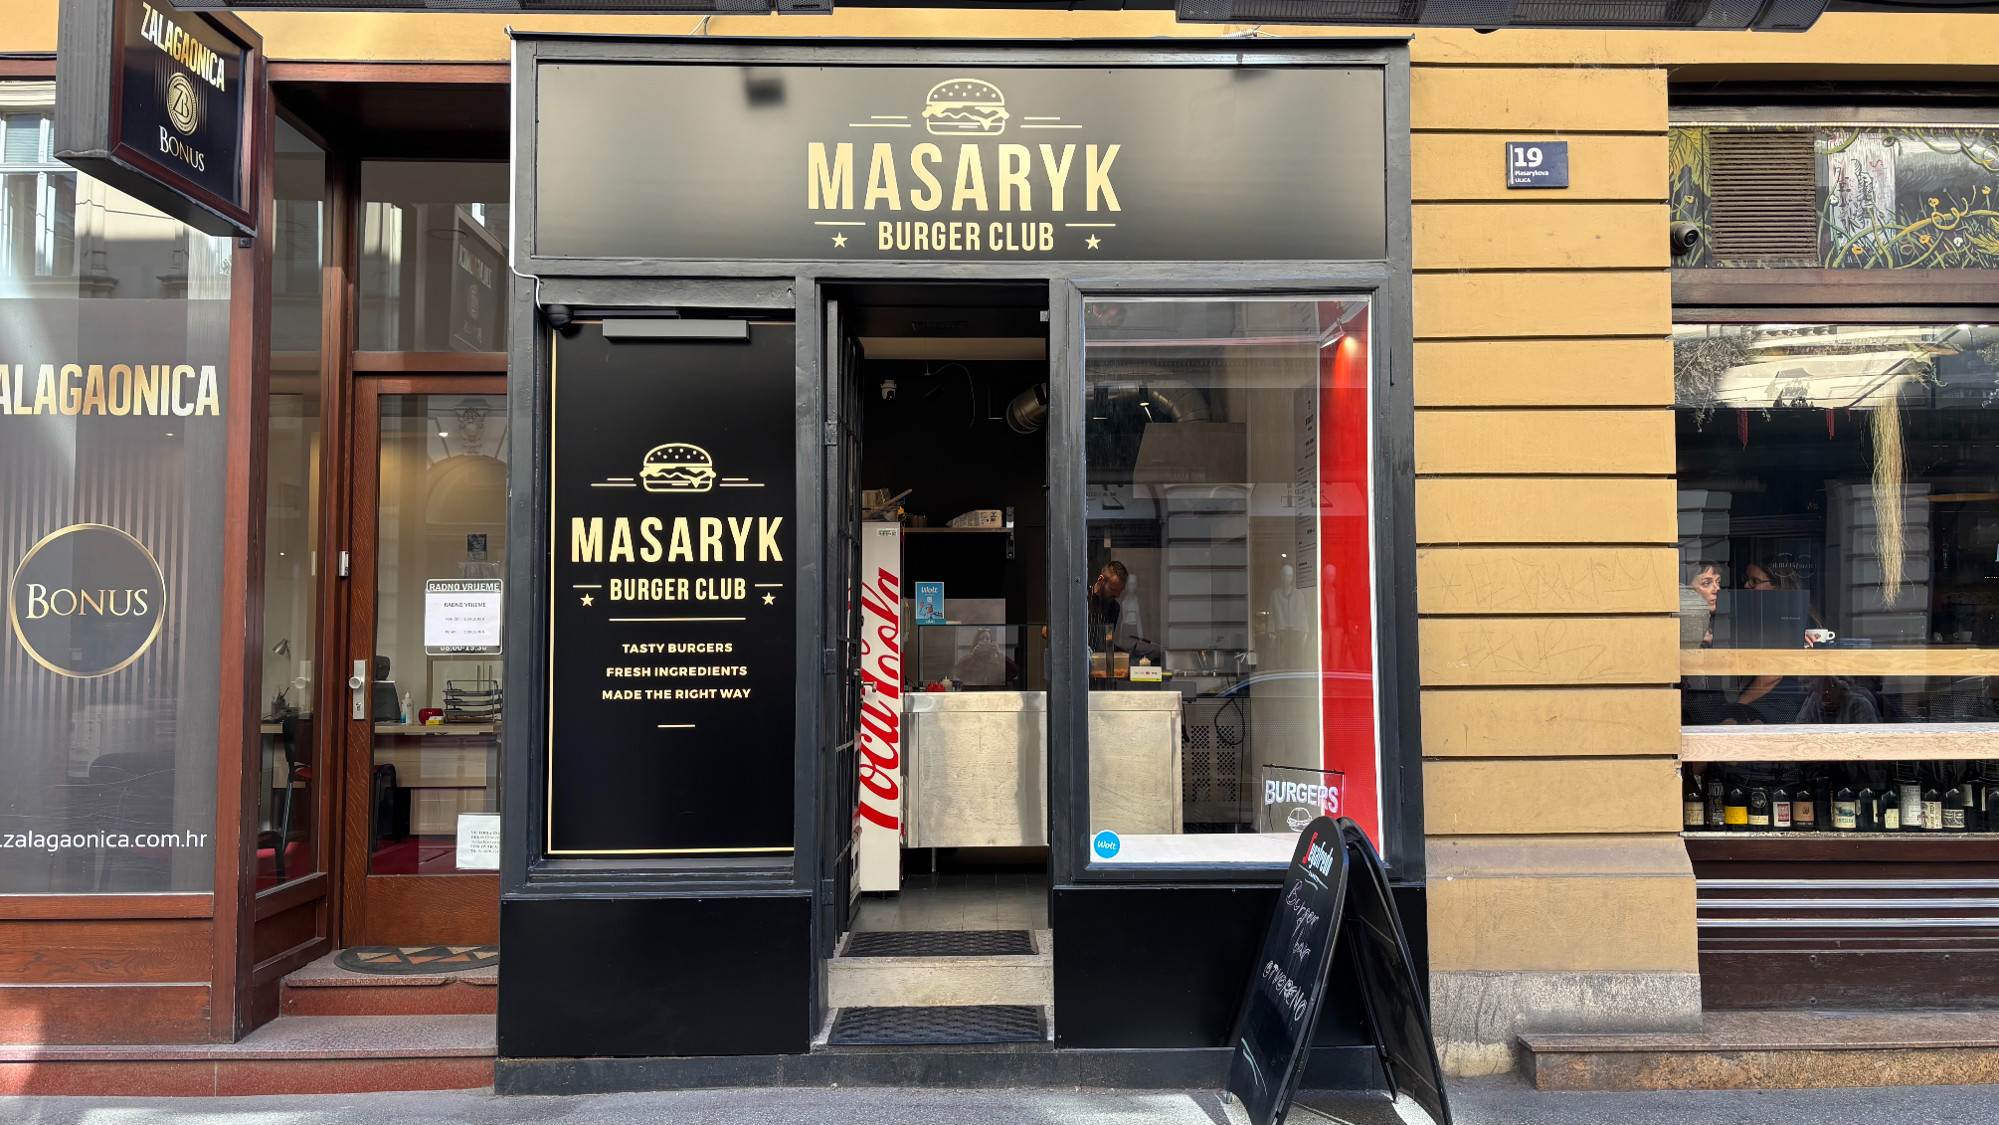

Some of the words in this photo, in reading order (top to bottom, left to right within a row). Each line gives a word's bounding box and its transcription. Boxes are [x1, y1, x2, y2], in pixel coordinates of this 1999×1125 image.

[141, 1, 225, 92] ZALAGAONICA
[159, 125, 205, 172] BONUS
[1514, 147, 1543, 167] 19
[808, 142, 1122, 212] MASARYK
[878, 221, 981, 251] BURGER
[989, 222, 1054, 251] CLUB
[571, 517, 784, 562] MASARYK
[25, 583, 149, 619] BONUS
[429, 583, 461, 591] RADNO
[462, 583, 500, 591] VRIJEME
[610, 578, 689, 601] BURGER
[695, 577, 746, 600] CLUB
[622, 643, 665, 654] TASTY
[667, 643, 733, 653] BURGERS
[606, 667, 651, 677] FRESH
[654, 666, 748, 677] INGREDIENTS
[602, 690, 642, 700] MADE
[645, 689, 672, 699] THE
[675, 689, 717, 699] RIGHT
[720, 688, 751, 699] WAY
[1265, 780, 1339, 813] BURGERS
[1097, 840, 1117, 850] Wolt
[1286, 879, 1319, 926] Burger
